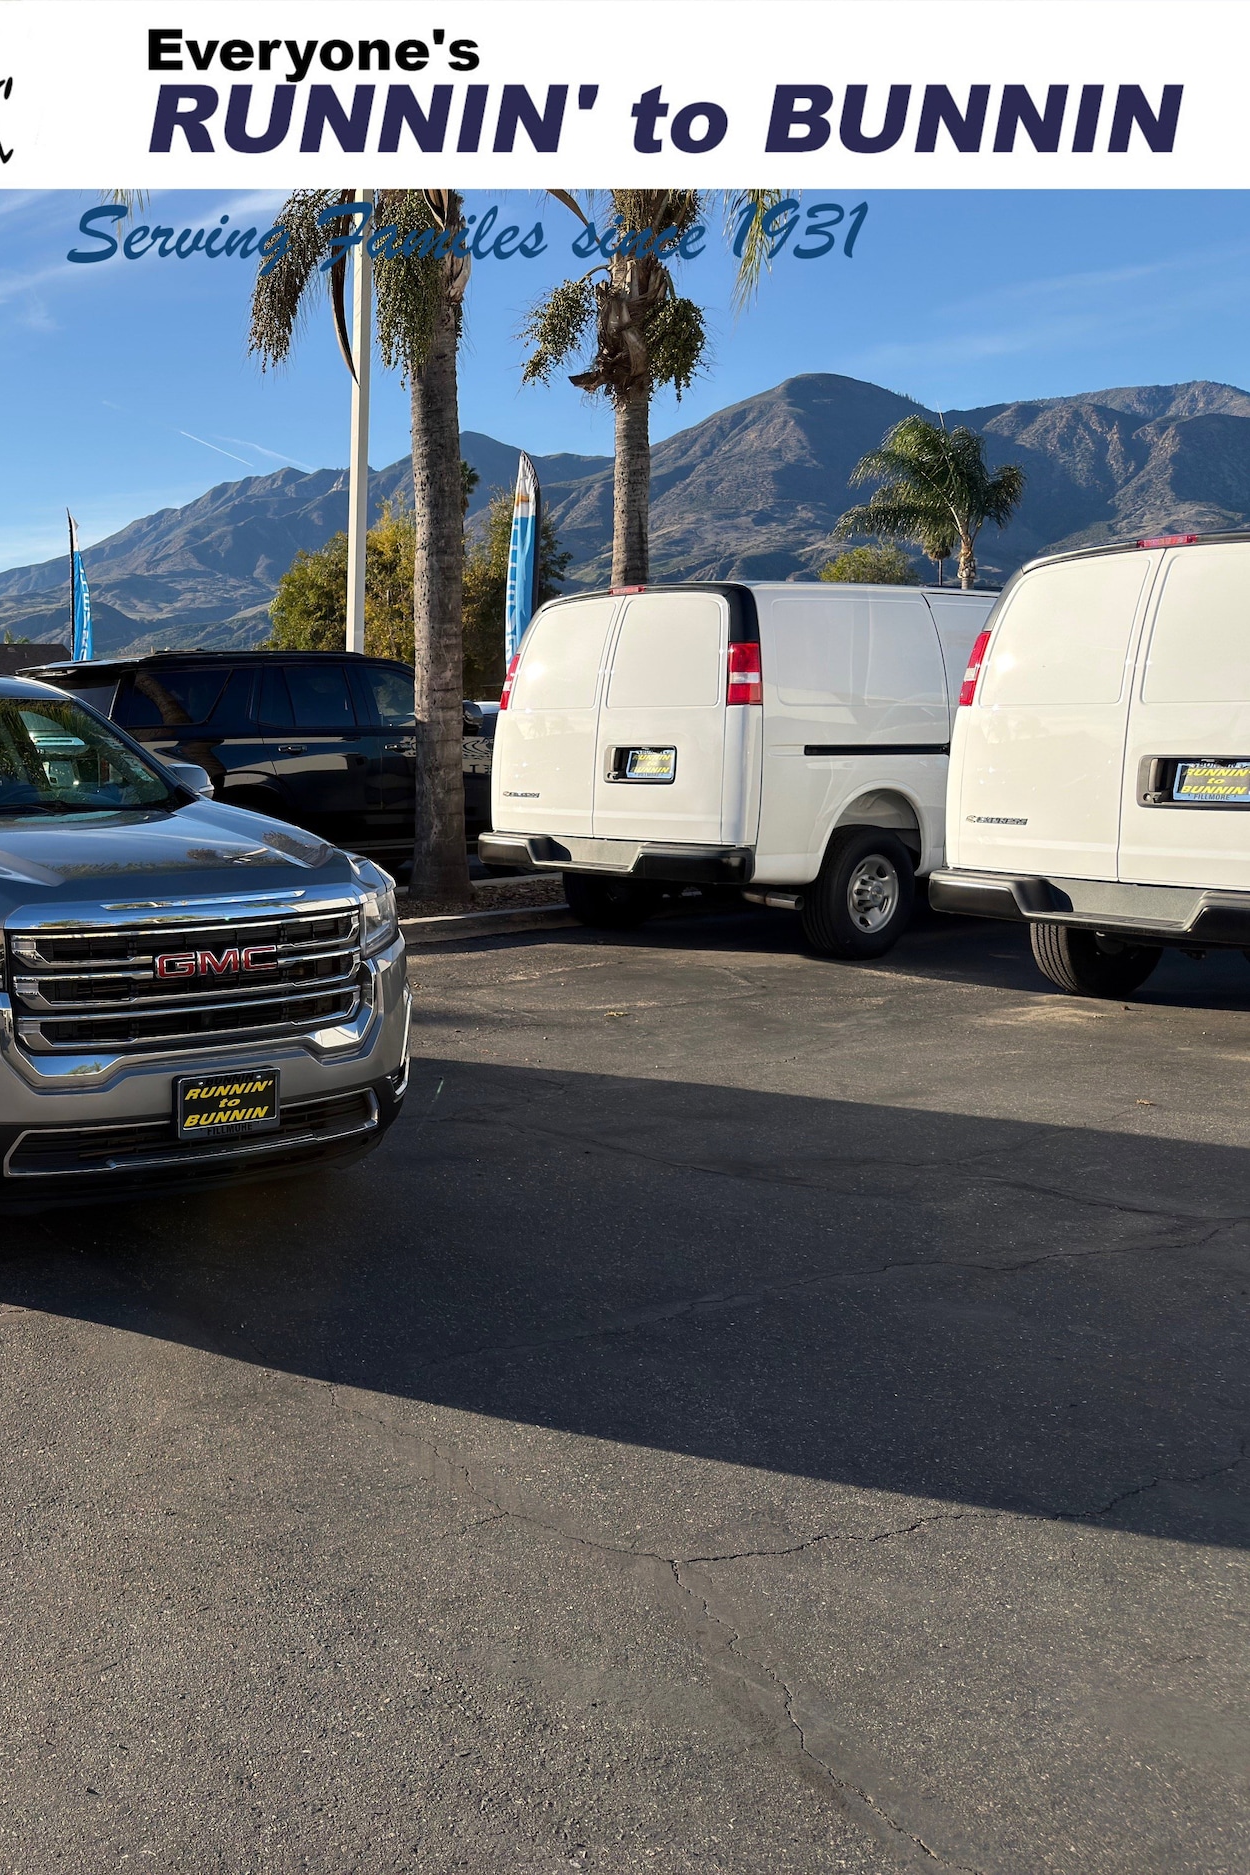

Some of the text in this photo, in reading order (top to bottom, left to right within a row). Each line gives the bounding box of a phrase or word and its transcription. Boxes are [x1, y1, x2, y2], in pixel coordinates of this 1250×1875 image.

[1180, 785, 1247, 795] BUNNIN
[156, 945, 278, 979] GMC
[184, 1080, 274, 1101] RUNNIN'
[218, 1098, 241, 1108] to
[183, 1106, 269, 1127] BUNNIN
